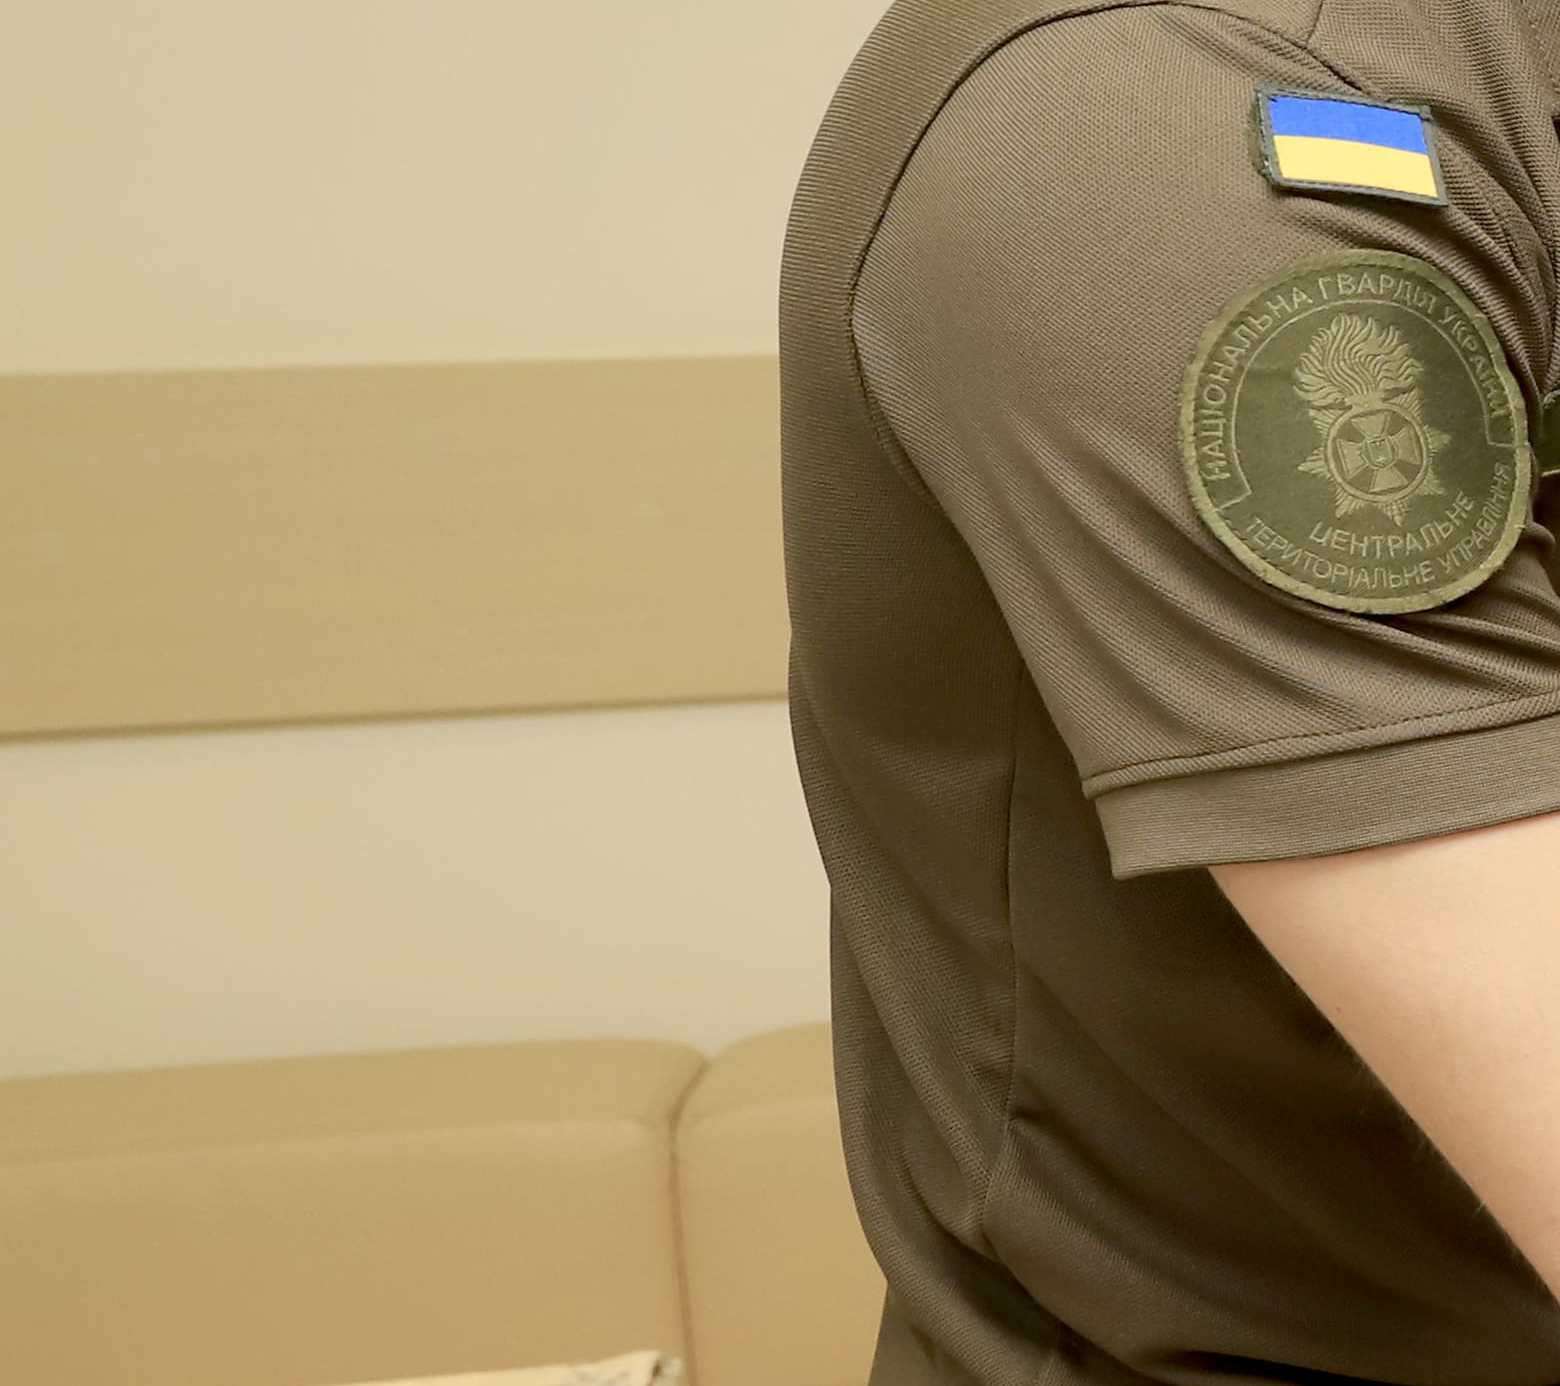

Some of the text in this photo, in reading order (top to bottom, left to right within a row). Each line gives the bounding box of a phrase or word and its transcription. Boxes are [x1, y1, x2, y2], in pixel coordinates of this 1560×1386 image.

[1201, 287, 1312, 481] НАЦІОНАЛЬНА
[1318, 273, 1437, 312] ГВАРДІЯ
[1440, 307, 1506, 418] УКРАЇНИ
[1246, 462, 1511, 590] ТЕРИТОРІАЛЬНЕ УПРАВЛІННЯ
[1309, 490, 1474, 559] ЦЕНТРАЛЬНЕ
